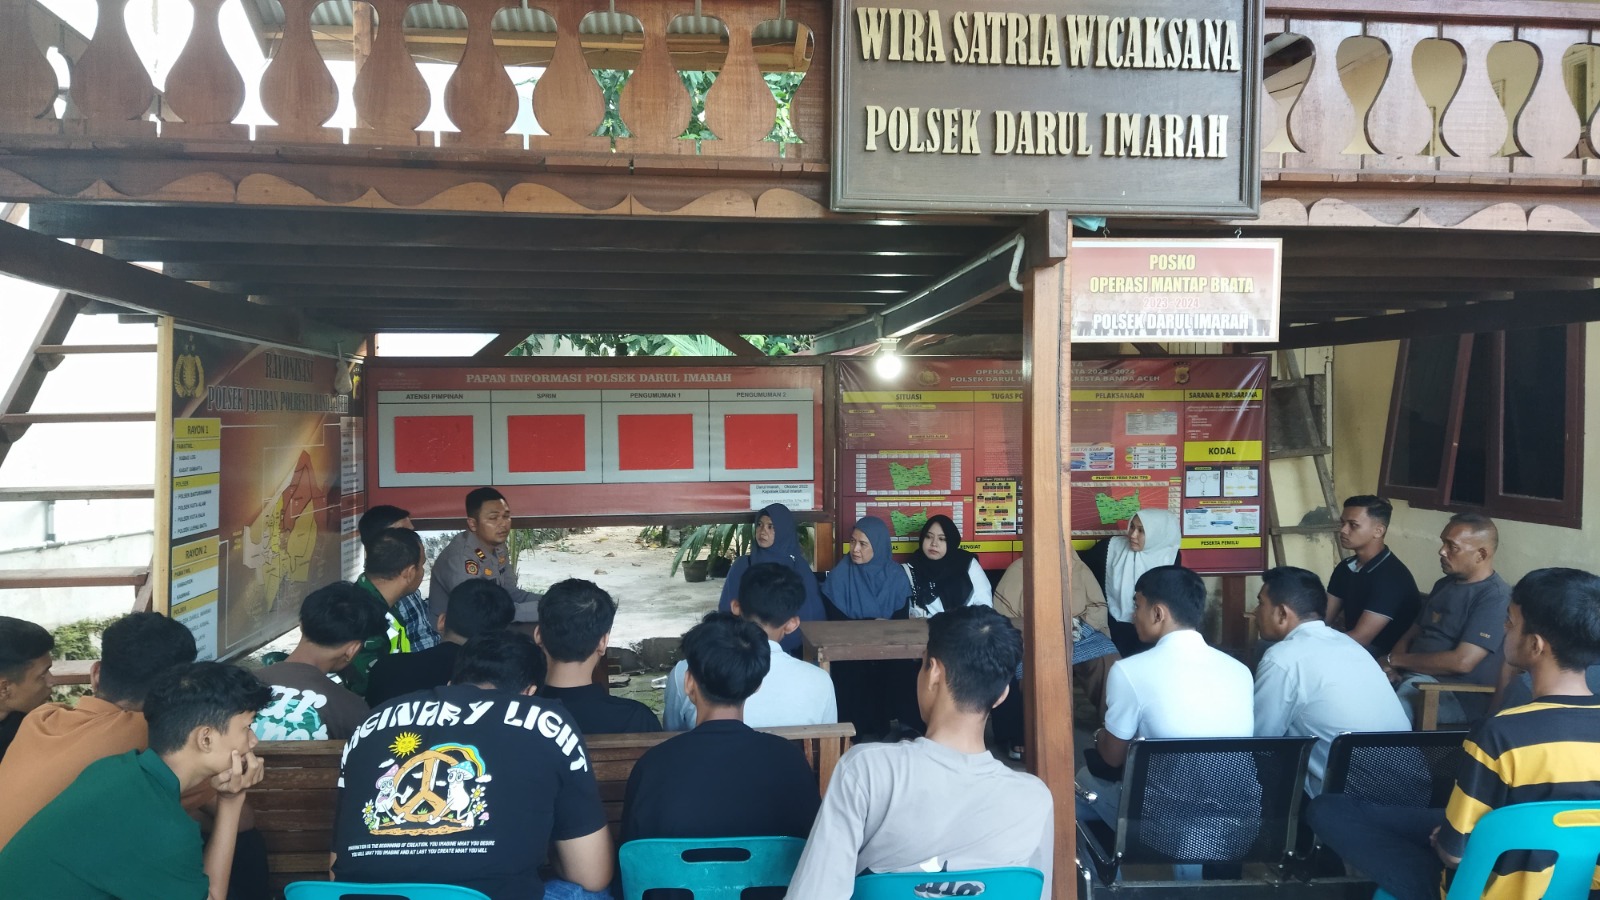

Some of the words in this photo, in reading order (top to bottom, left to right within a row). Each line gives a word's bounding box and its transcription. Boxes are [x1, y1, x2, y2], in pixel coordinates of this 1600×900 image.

[856, 7, 947, 64] WIRA
[953, 11, 1062, 68] SATRIA
[1065, 14, 1241, 72] WICAKSANA
[865, 105, 982, 155] POLSEK
[994, 110, 1093, 157] DARUL
[1103, 112, 1229, 159] IMARAH
[1149, 254, 1196, 271] POSKO
[1089, 276, 1148, 294] OPERASI
[1150, 276, 1208, 293] MANTAP
[1210, 276, 1255, 293] BRATA
[1143, 297, 1168, 308] 2023
[1175, 297, 1199, 308] 2024
[1093, 313, 1146, 330] POLSEK
[1147, 313, 1192, 330] DARUL
[1193, 313, 1249, 330] IMARAH
[466, 374, 506, 383] PAPAN
[510, 374, 582, 383] INFORMASI
[586, 373, 636, 383] POLSEK
[639, 373, 680, 383] DARUL
[684, 373, 732, 382] IMARAH
[207, 385, 244, 410] POLSEK
[187, 426, 204, 434] RAYON
[1208, 447, 1236, 455] KODAL
[185, 548, 203, 559] RAYON
[503, 701, 588, 773] LIGHT
